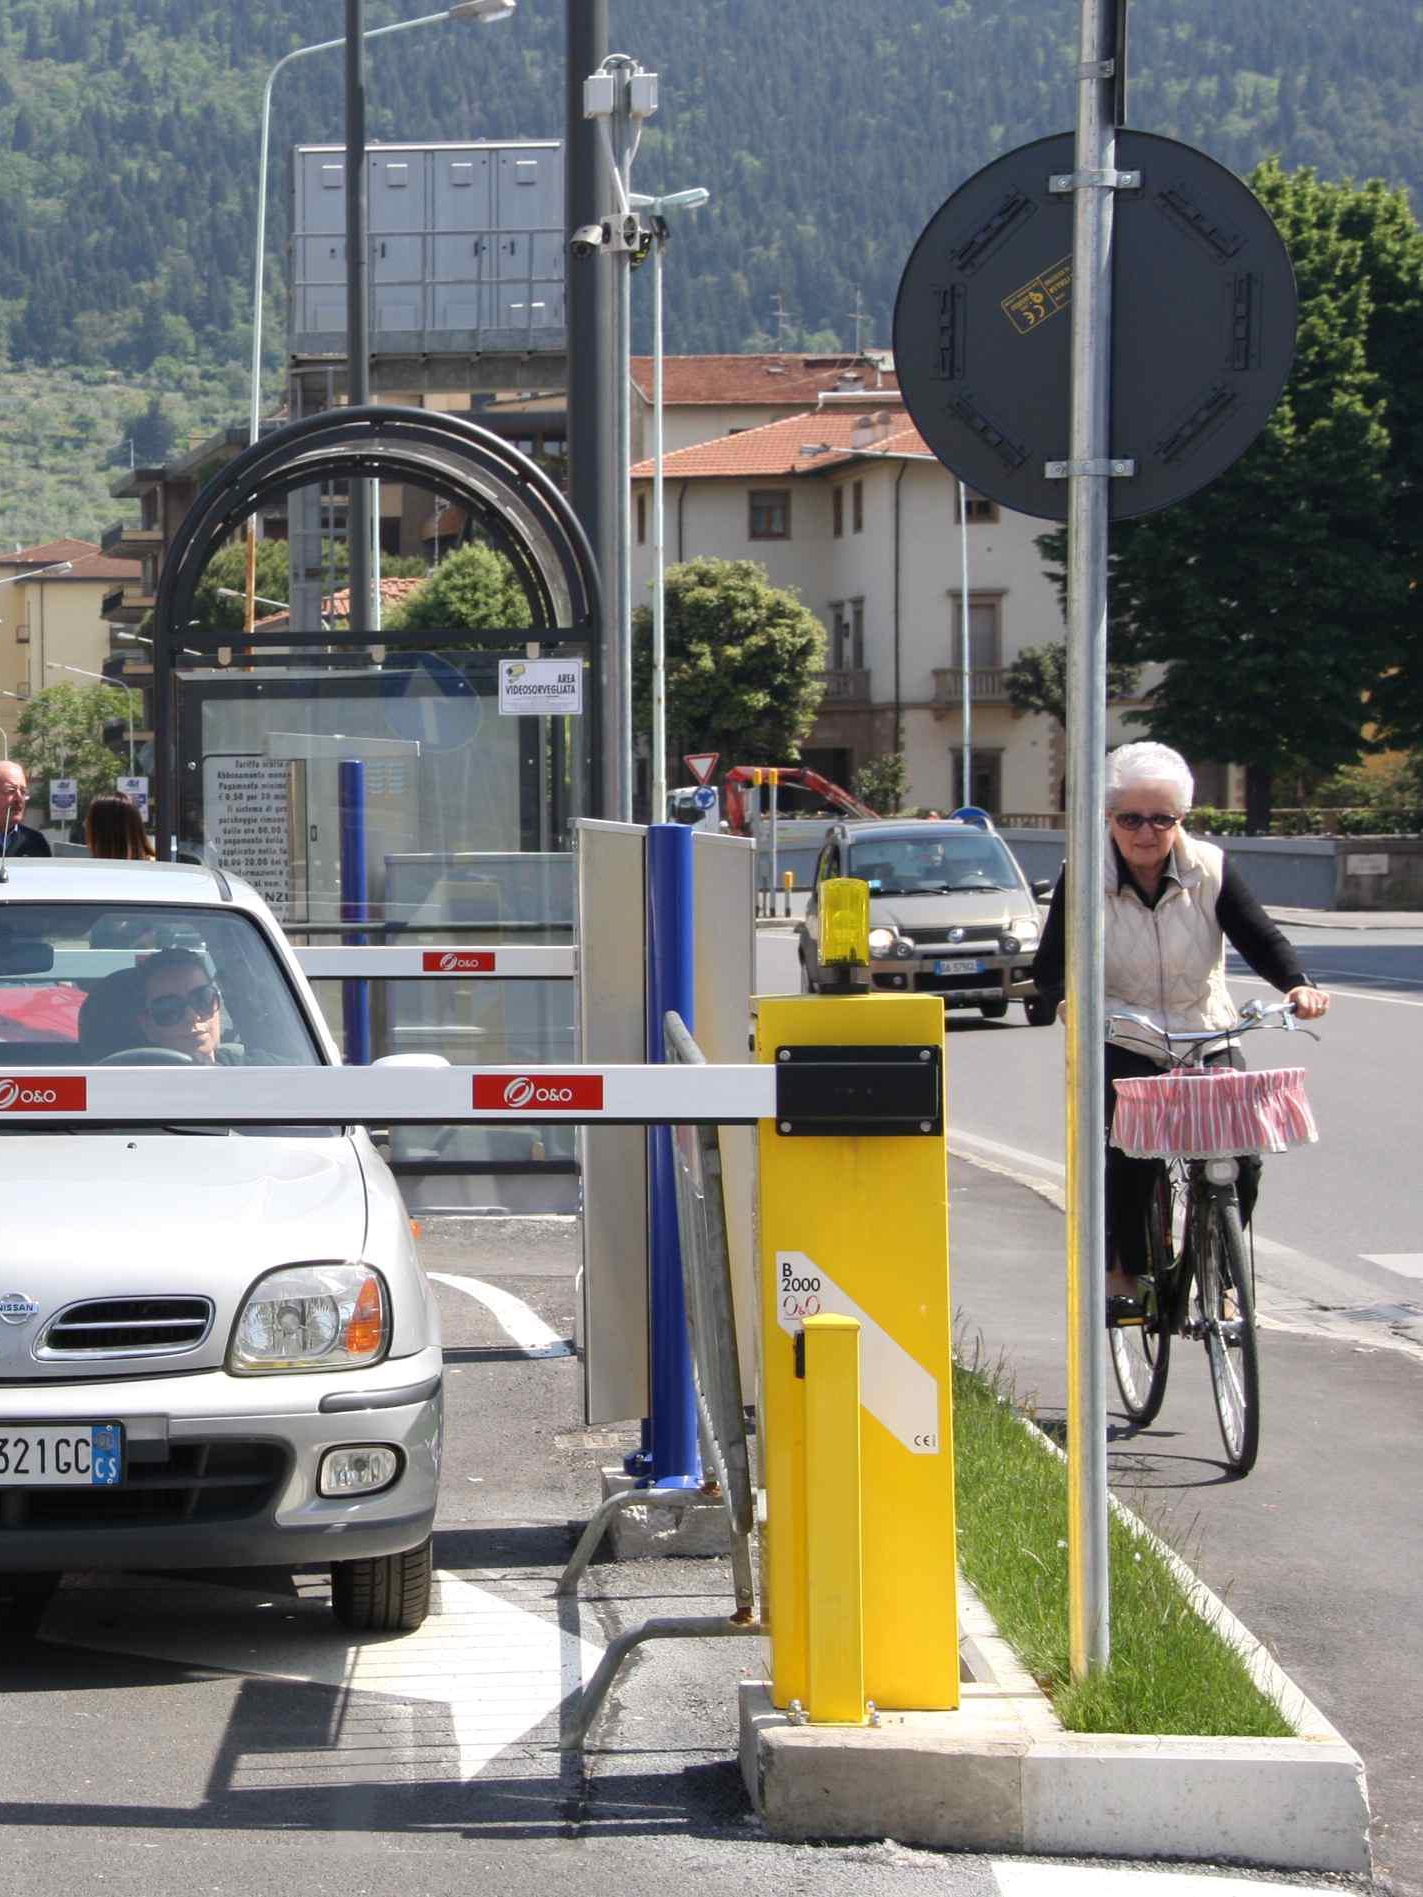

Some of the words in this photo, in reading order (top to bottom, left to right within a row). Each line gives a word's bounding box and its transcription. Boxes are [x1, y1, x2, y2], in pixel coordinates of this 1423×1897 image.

[558, 673, 576, 683] AREA
[505, 685, 576, 695] VIDEOSORVEGLIATA
[218, 782, 259, 790] Pagamento
[20, 1089, 57, 1103] O&O
[536, 1087, 573, 1102] O&O
[782, 1263, 793, 1278] B
[782, 1277, 821, 1292] 2000
